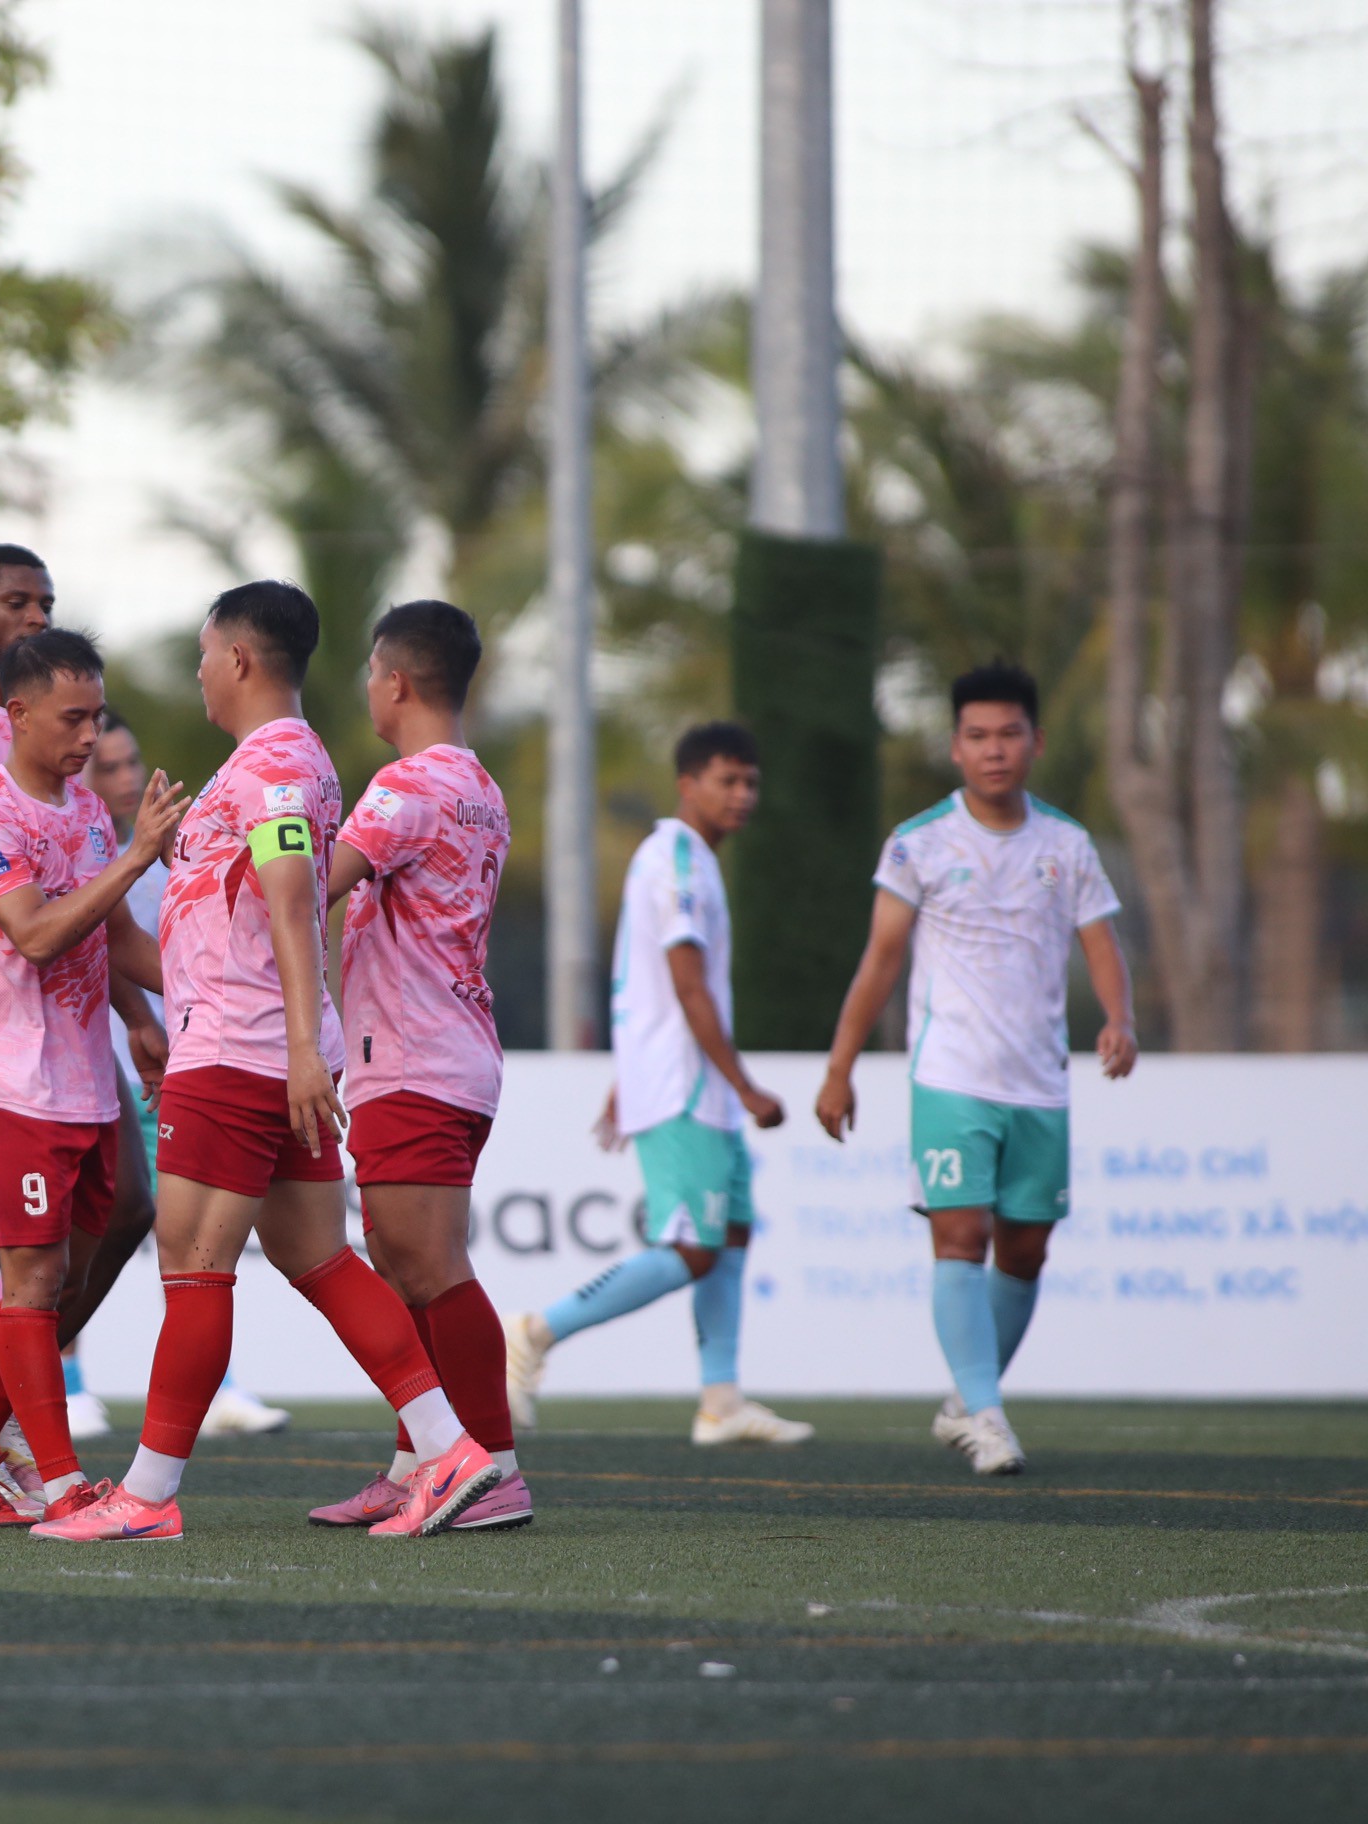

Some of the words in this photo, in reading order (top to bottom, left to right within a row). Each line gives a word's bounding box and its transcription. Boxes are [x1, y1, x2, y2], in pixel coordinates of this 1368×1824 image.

[267, 803, 305, 814] NetSpace
[277, 823, 306, 851] C
[923, 1148, 964, 1189] 73
[22, 1172, 49, 1216] 9
